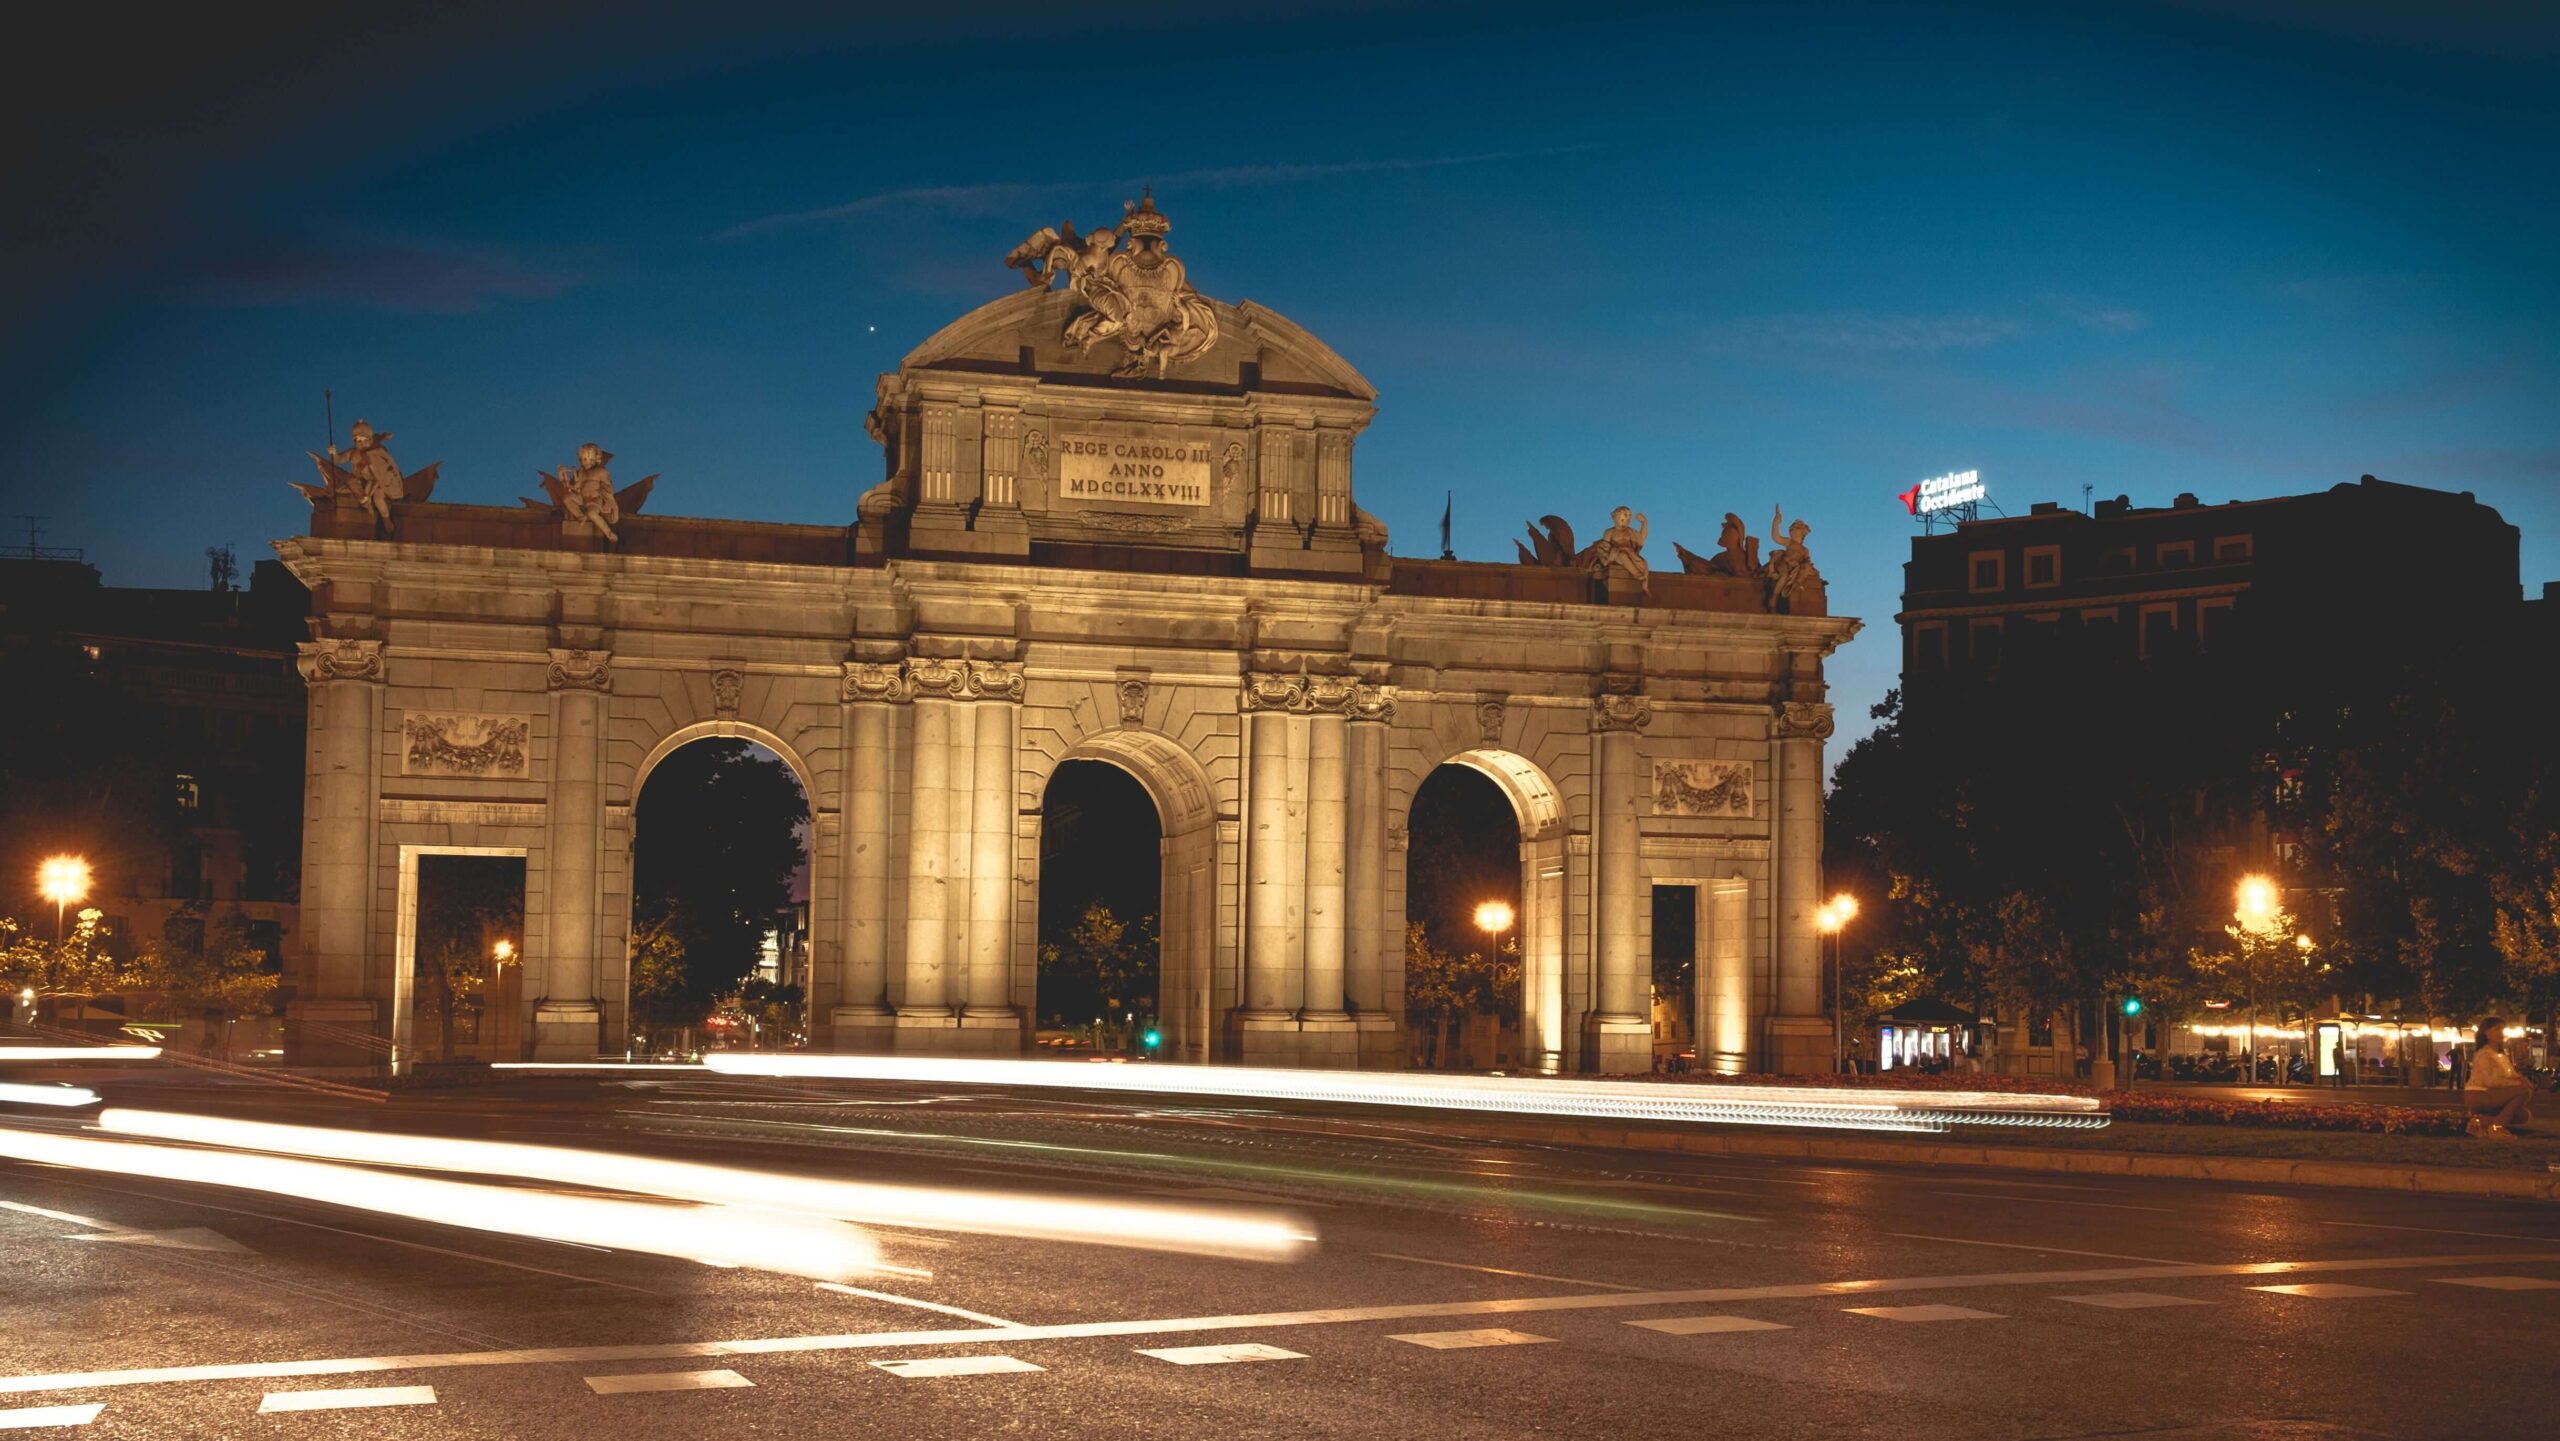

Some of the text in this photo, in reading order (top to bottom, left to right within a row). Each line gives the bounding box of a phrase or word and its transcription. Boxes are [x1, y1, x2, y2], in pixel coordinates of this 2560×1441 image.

[1061, 441, 1211, 463] REGE CAROLO III
[1108, 463, 1164, 478] ANNO
[1070, 478, 1201, 499] MDCCLXXVIII
[1920, 470, 1978, 495] Catalana
